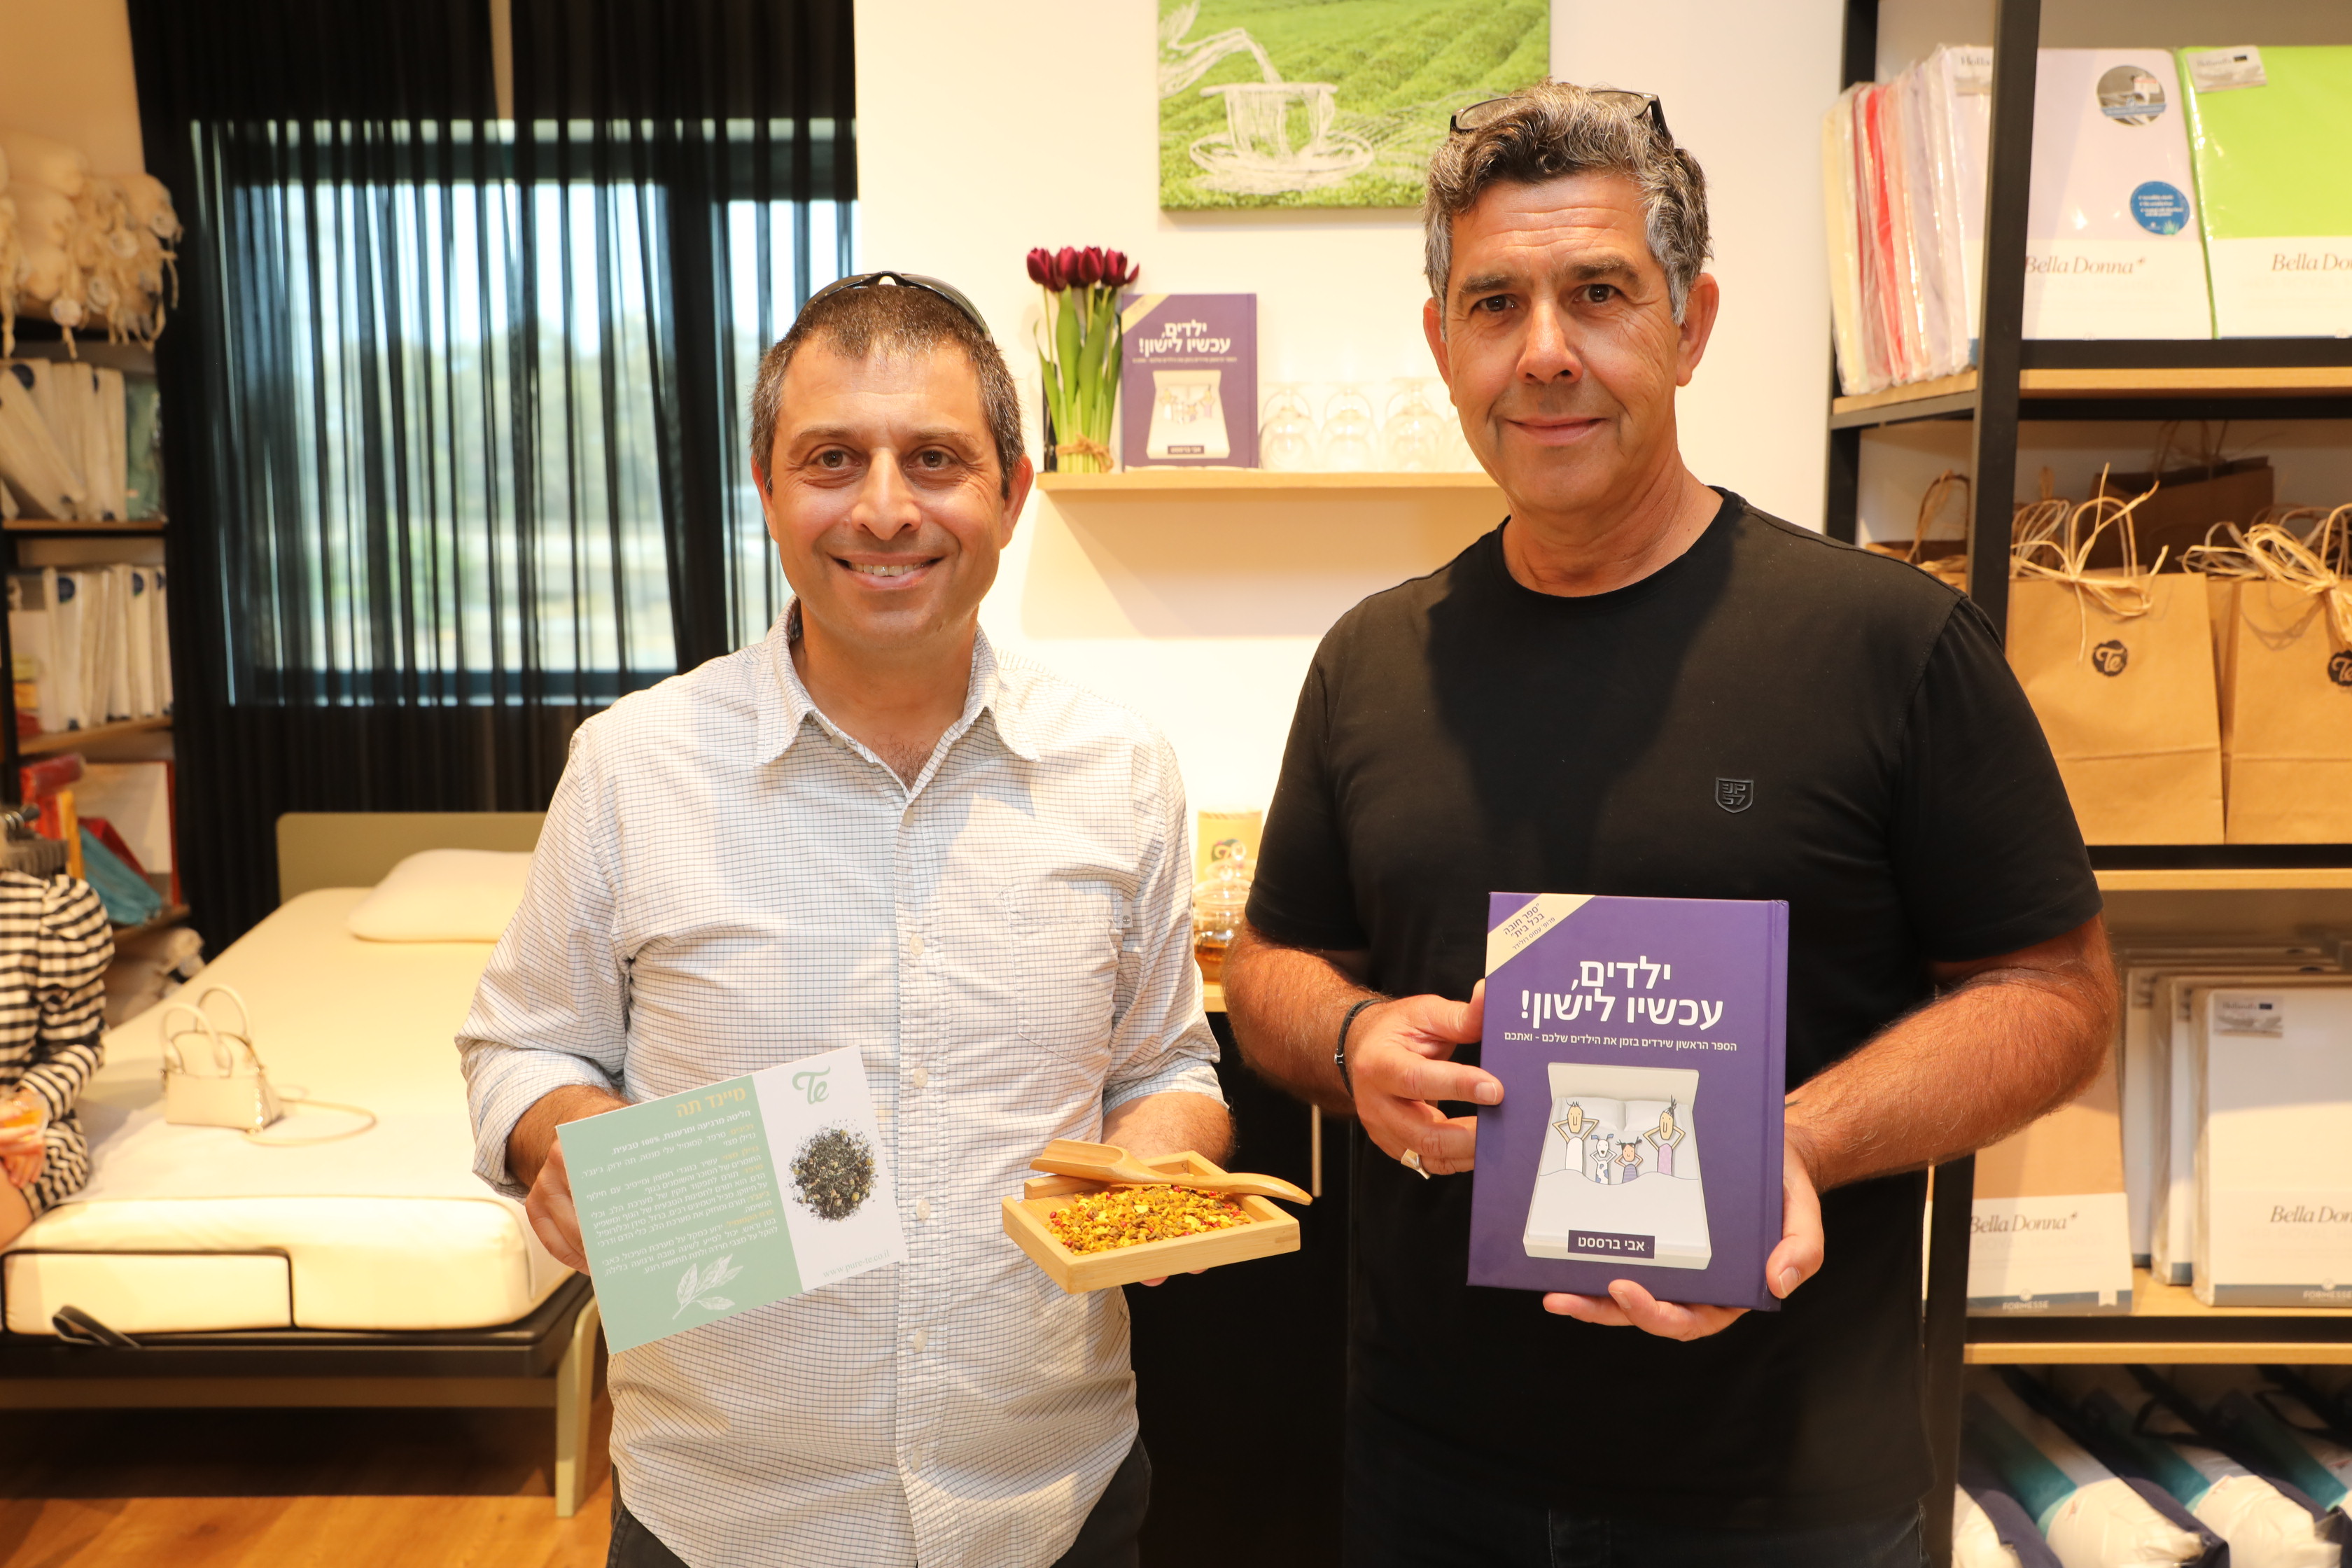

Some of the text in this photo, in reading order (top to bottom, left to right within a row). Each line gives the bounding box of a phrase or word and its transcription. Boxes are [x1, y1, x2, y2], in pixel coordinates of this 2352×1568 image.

[2025, 255, 2134, 274] Bella Donna
[2272, 253, 2318, 272] Bella
[1161, 319, 1208, 339] ילדים,
[1138, 335, 1231, 358] עכשיו לישון!
[1527, 913, 1545, 926] בכל
[1503, 918, 1522, 935] חובה
[1529, 927, 1541, 939] עמוס
[1512, 937, 1530, 950] רולידר
[1571, 955, 1671, 991] ילדים,
[1521, 988, 1723, 1030] עכשיו לישון!
[1504, 1032, 1533, 1041] ואתכם
[1541, 1032, 1569, 1043] שלכם
[1570, 1034, 1601, 1044] הילדים
[1619, 1037, 1639, 1049] בזמן
[1642, 1038, 1674, 1048] שירדים
[1676, 1040, 1709, 1051] הראשון
[1711, 1042, 1737, 1051] הספר
[792, 1065, 831, 1105] Te
[676, 1087, 746, 1118] מיינד תה
[726, 1110, 751, 1122] חליטה
[696, 1117, 725, 1130] מרגיעה
[640, 1135, 661, 1146] 100%
[676, 1138, 703, 1150] קמומיל
[739, 1132, 756, 1144] גדילן
[676, 1164, 697, 1174] בנוגדי
[699, 1158, 718, 1168] עשיר
[652, 1170, 674, 1183] חמצון
[696, 1168, 718, 1178] הסוכר
[721, 1171, 738, 1181] תורם
[690, 1177, 717, 1189] לתפקוד
[715, 1182, 733, 1193] תורם
[586, 1190, 607, 1202] חילוף
[716, 1192, 734, 1201] מכיל
[627, 1196, 653, 1209] מערכת
[654, 1198, 682, 1211] הטבעית
[728, 1198, 746, 1208] תורם
[622, 1210, 639, 1221] הגוף
[705, 1203, 727, 1217] ומחזק
[2270, 1205, 2315, 1222] Bella
[593, 1216, 621, 1230] ומשפיע
[666, 1214, 692, 1227] מערכת
[1970, 1214, 2066, 1233] Bella Donna
[617, 1232, 634, 1242] הדם
[687, 1228, 708, 1241] כמקל
[758, 1226, 778, 1238] להקל
[597, 1237, 616, 1247] ודרכי
[703, 1233, 722, 1245] לסייע
[729, 1236, 747, 1247] מצבי
[1578, 1237, 1645, 1252] אבי ברססט
[648, 1239, 674, 1252] מערכת
[678, 1240, 699, 1253] לשינה
[708, 1242, 728, 1253] חרדה
[657, 1249, 676, 1259] טובה
[689, 1249, 707, 1259] ולתת
[602, 1256, 620, 1266] כאבי
[631, 1255, 654, 1268] ורגועה
[662, 1255, 687, 1268] תחושת
[823, 1250, 890, 1278] www.pure-te.co.il
